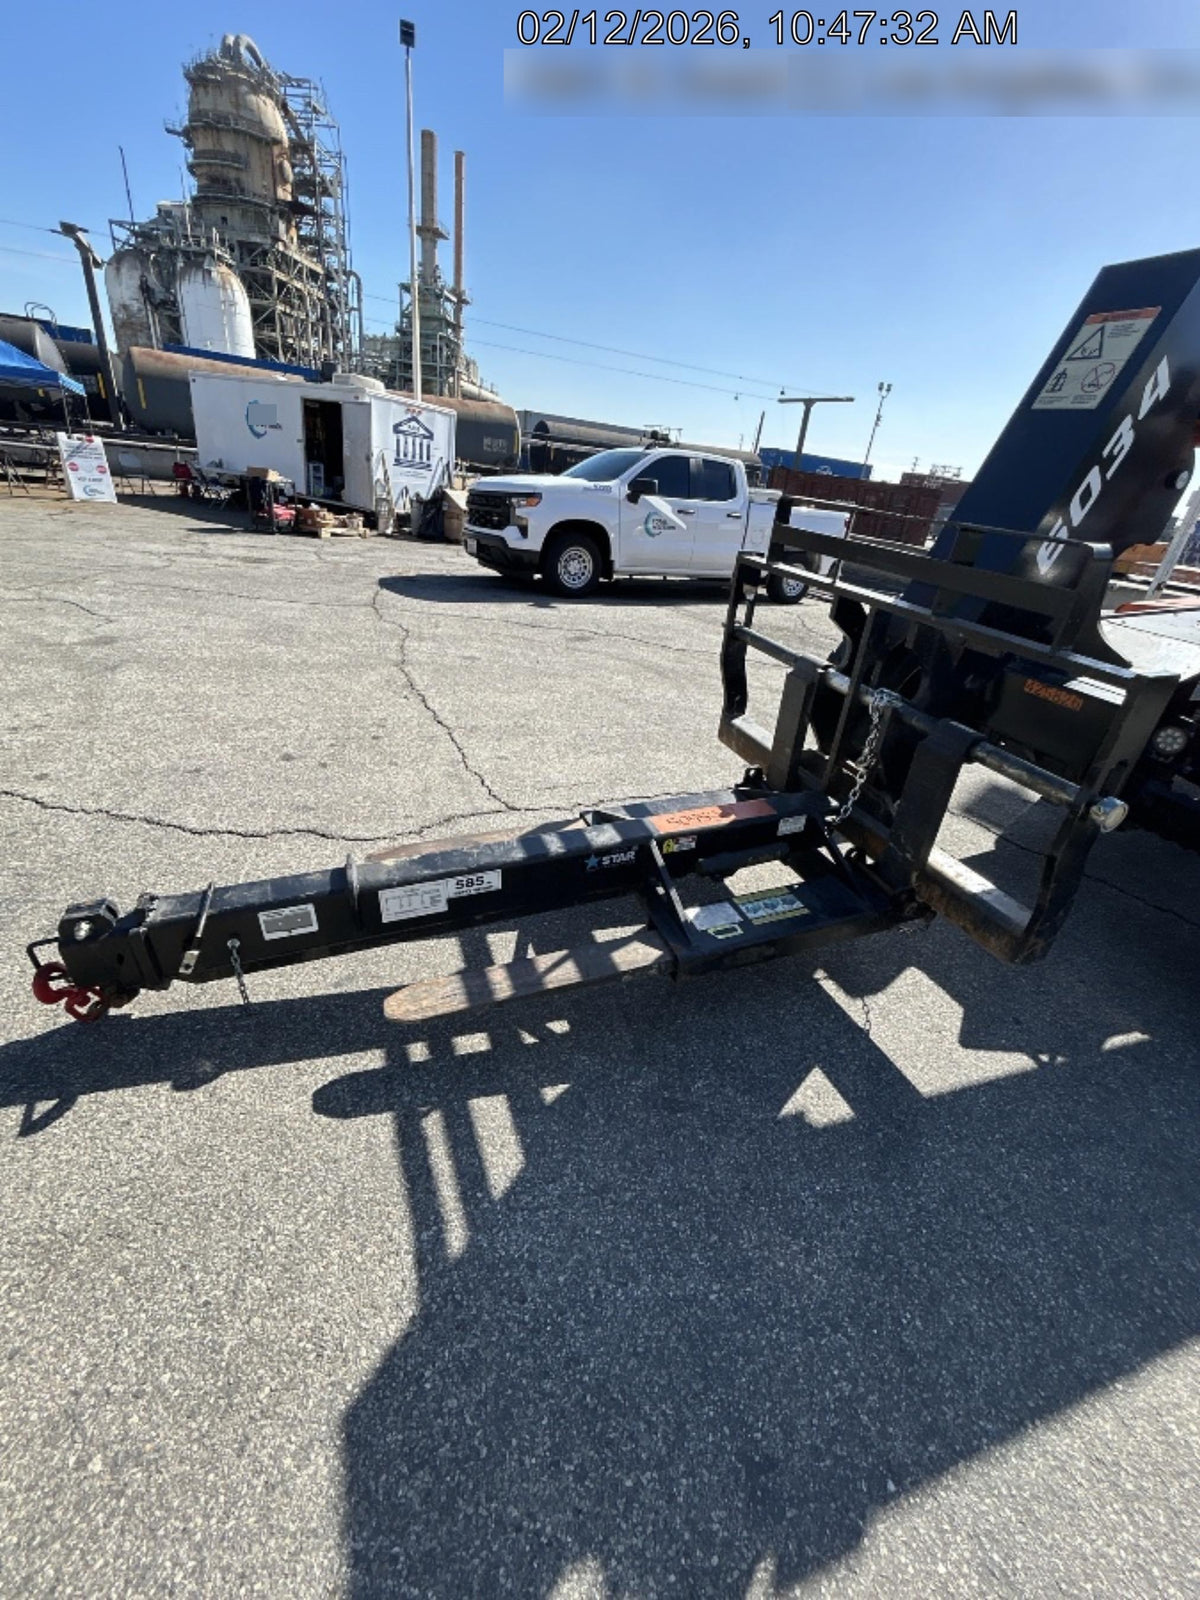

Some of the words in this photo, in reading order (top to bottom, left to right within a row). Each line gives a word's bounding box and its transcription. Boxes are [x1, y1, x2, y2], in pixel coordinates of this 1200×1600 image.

[1036, 355, 1171, 576] 6034
[602, 851, 636, 865] STAR
[455, 875, 485, 890] 585
